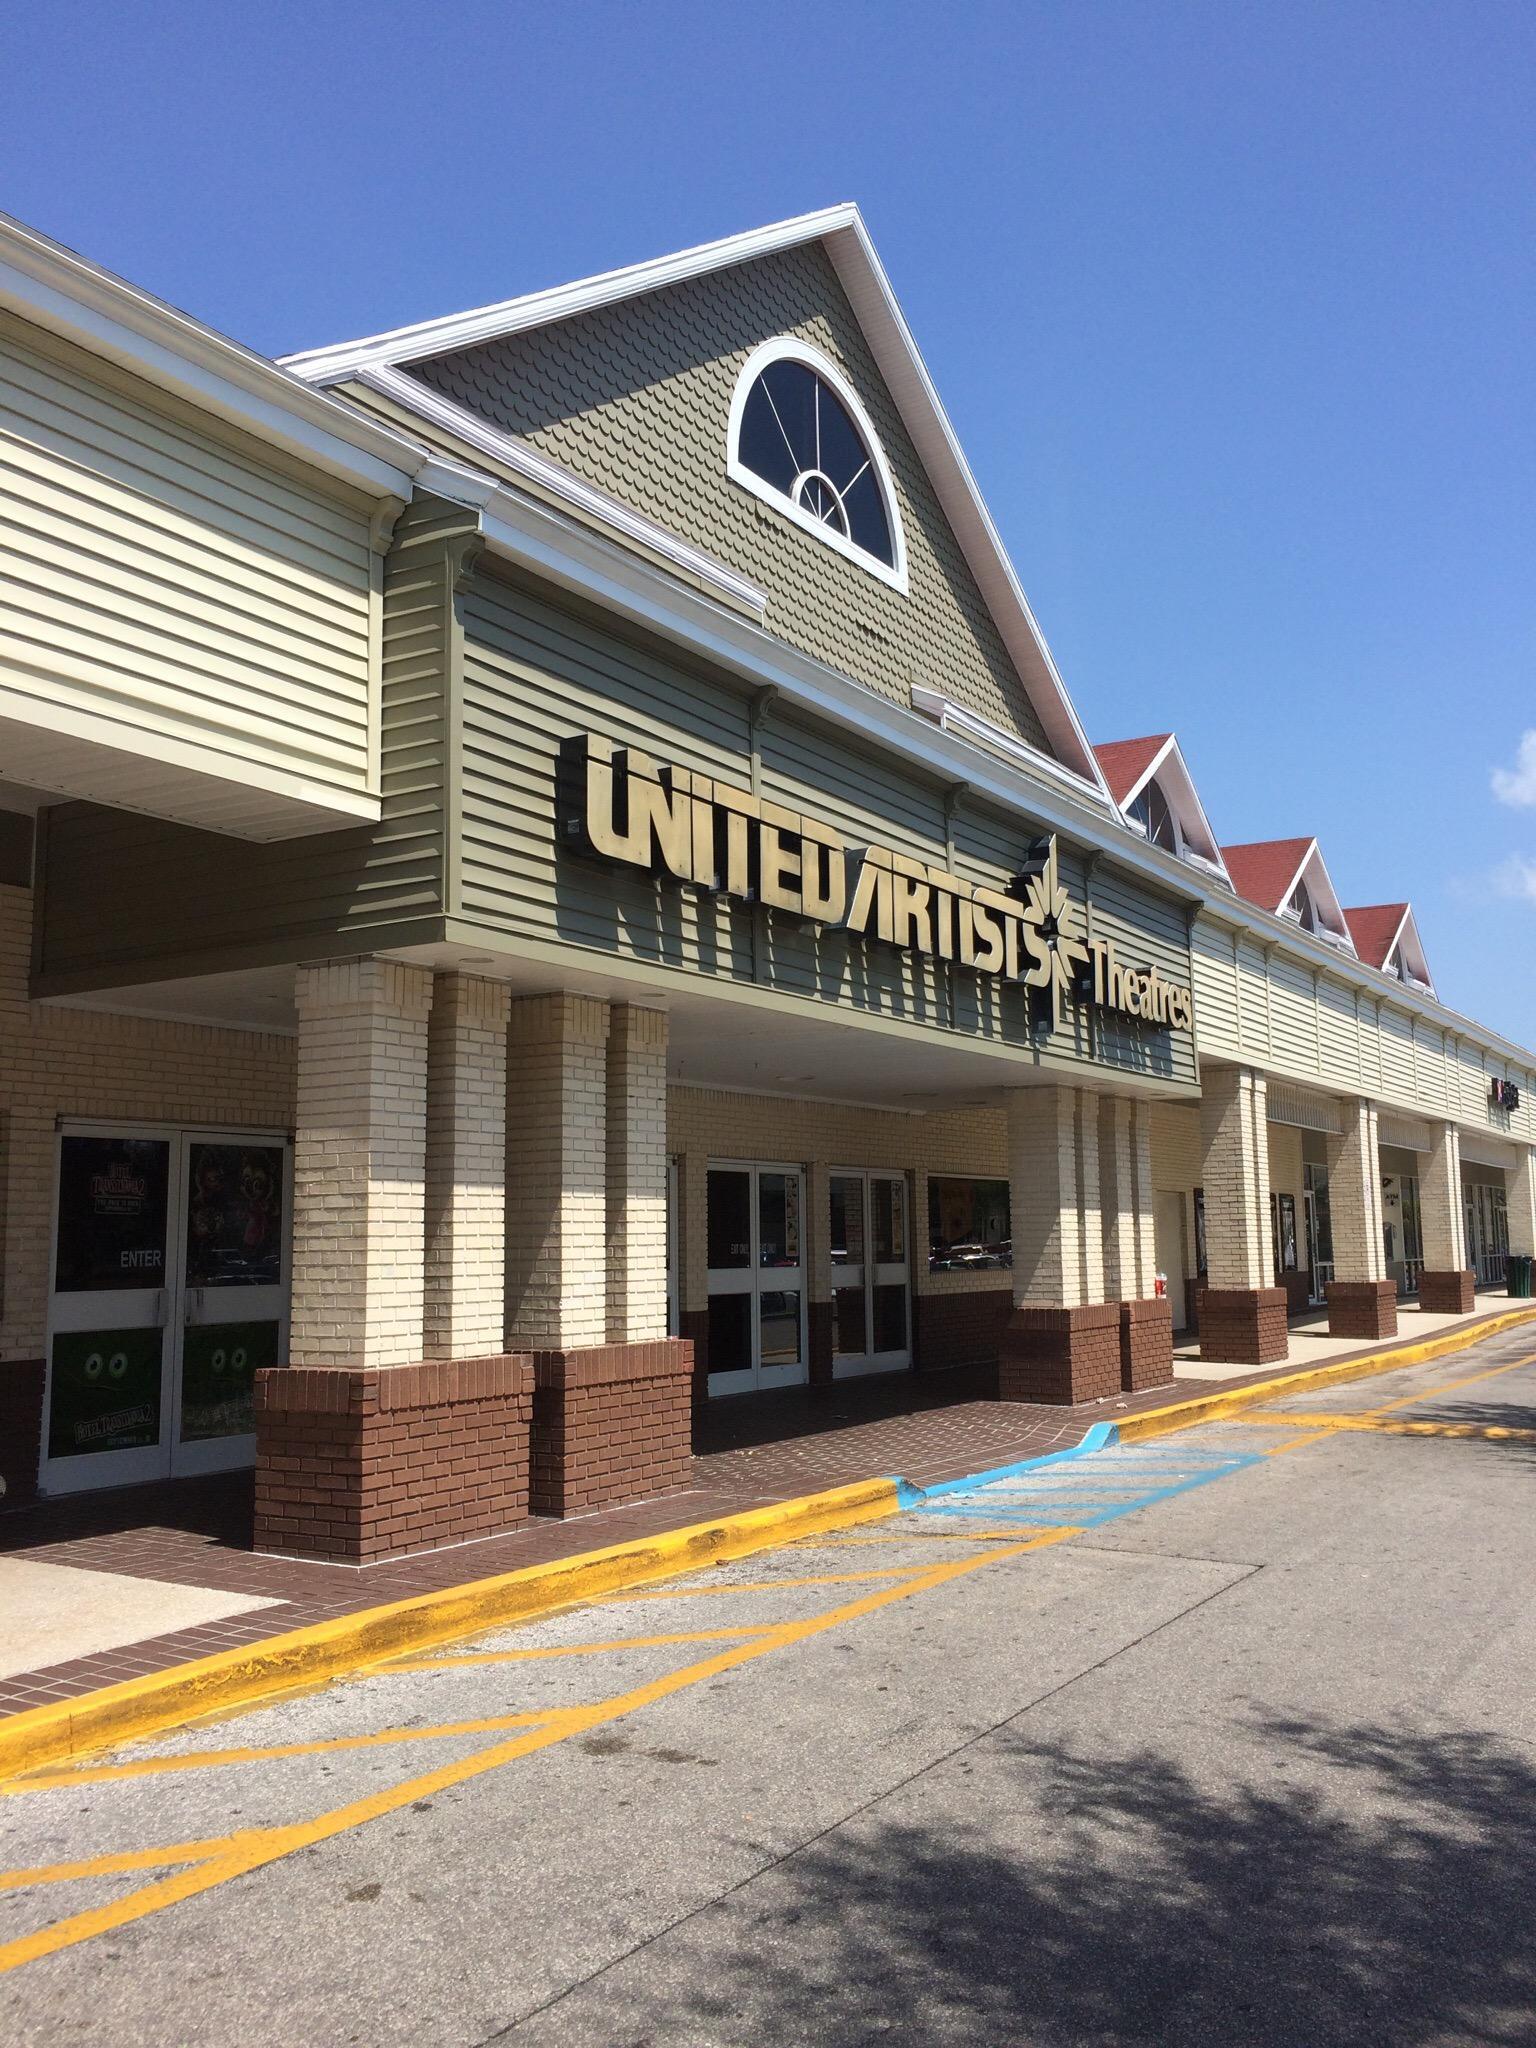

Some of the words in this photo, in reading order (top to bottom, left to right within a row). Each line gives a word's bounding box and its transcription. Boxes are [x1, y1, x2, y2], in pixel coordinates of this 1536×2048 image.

[585, 731, 846, 925] UNITED
[846, 844, 1052, 988] ARTISTS
[1087, 938, 1193, 1031] Theatres
[120, 1250, 161, 1268] ENTER
